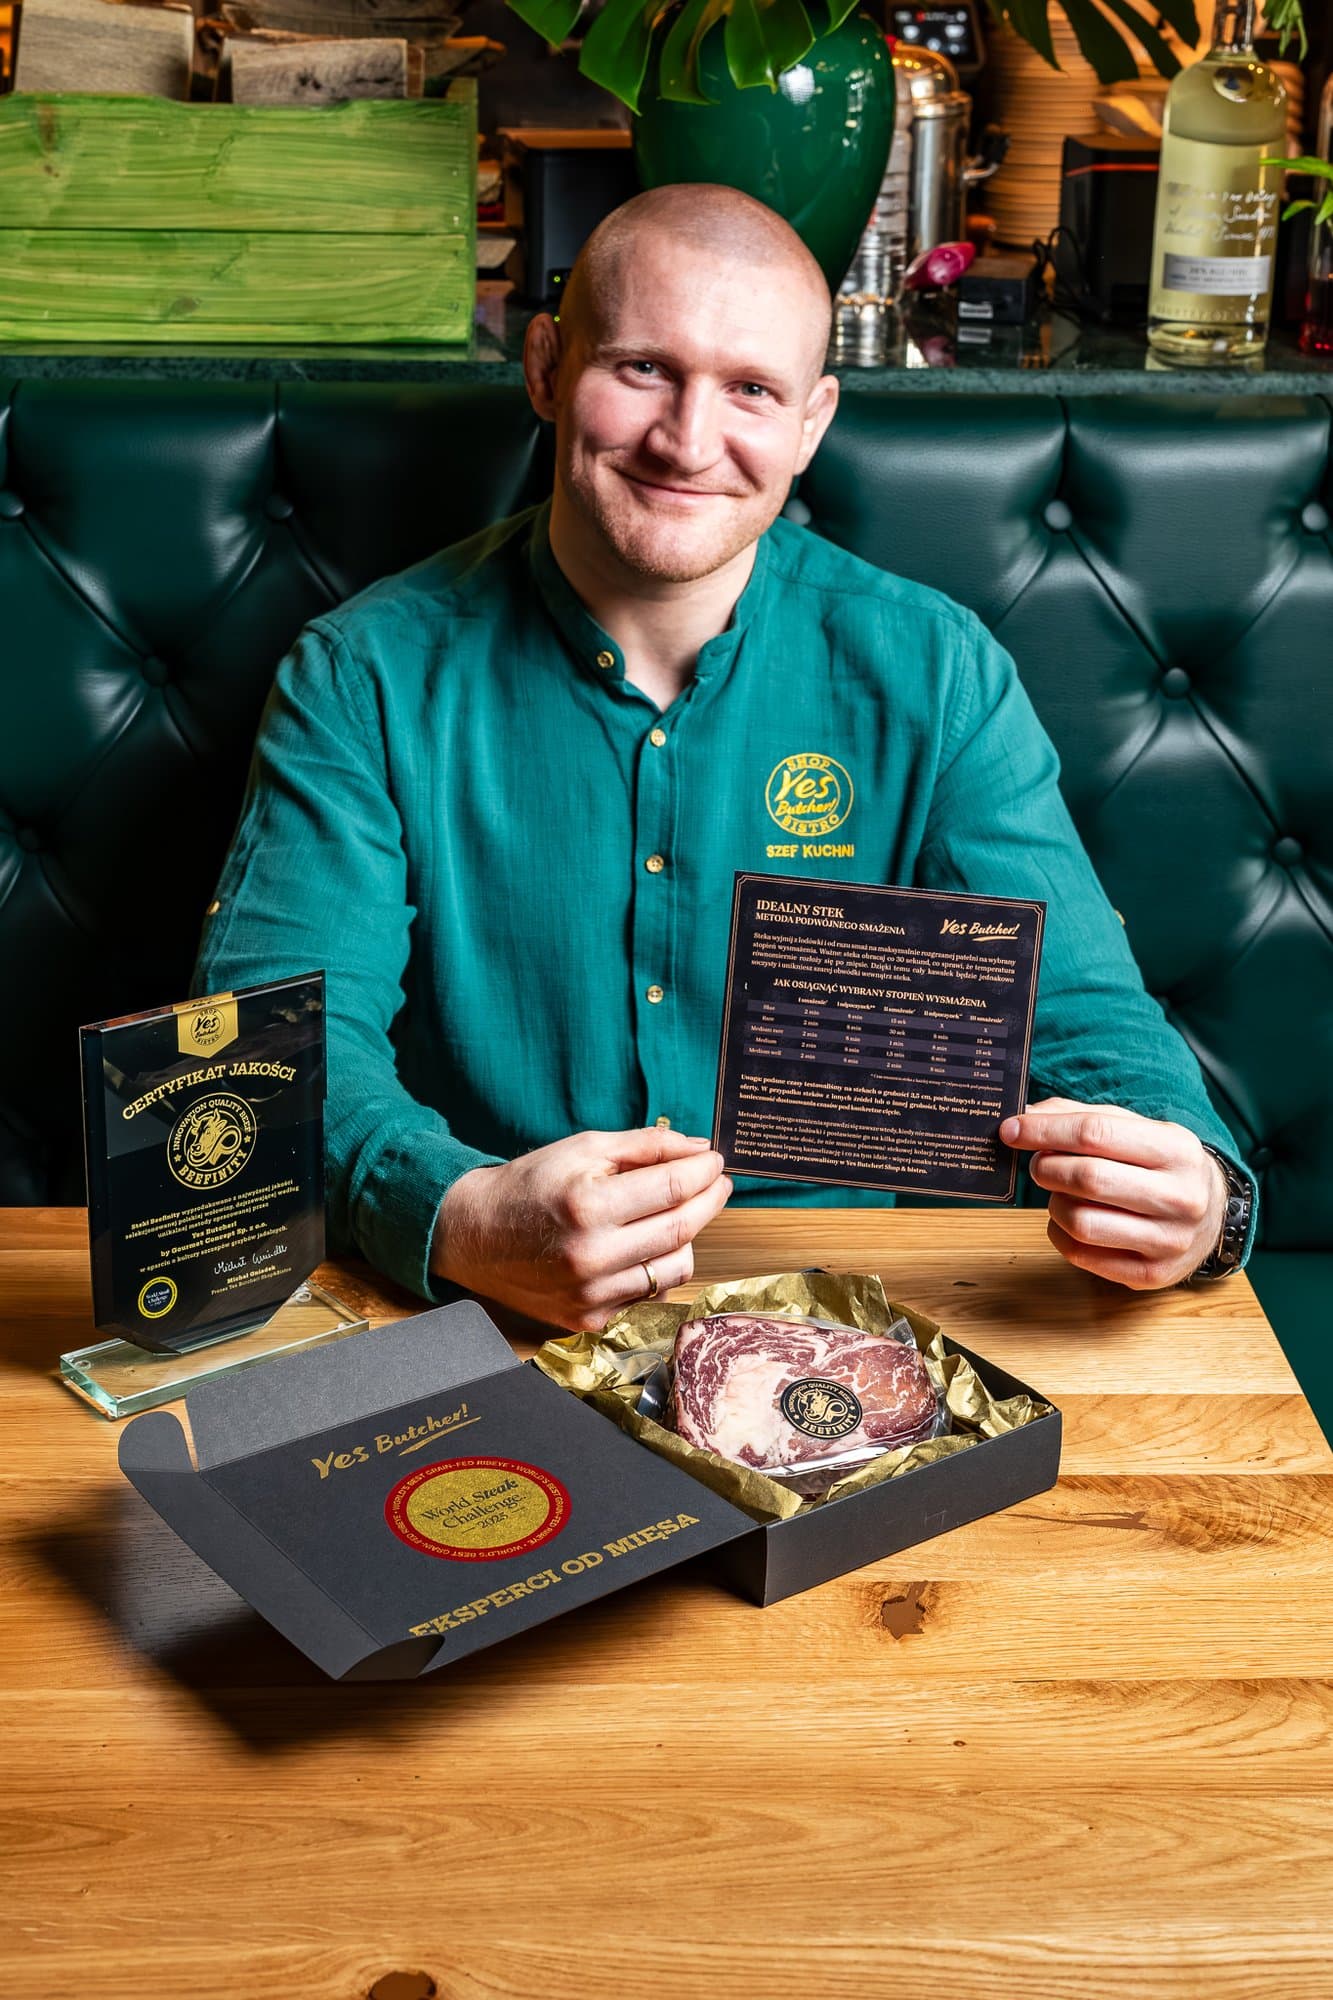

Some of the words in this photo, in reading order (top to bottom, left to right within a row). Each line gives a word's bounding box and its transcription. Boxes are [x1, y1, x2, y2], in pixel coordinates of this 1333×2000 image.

[786, 756, 831, 772] SHOP
[774, 770, 834, 802] Yes
[775, 798, 838, 816] Butcher!
[782, 814, 840, 832] BISTRO
[766, 844, 798, 858] SZEF
[802, 844, 854, 858] KUCHNI
[757, 899, 810, 914] IDEALNY
[812, 905, 843, 918] STEK
[755, 912, 793, 923] METODA
[795, 916, 857, 929] PODWÓJNEGO
[858, 923, 904, 934] SMAŻENIA
[940, 919, 967, 934] Yes
[968, 922, 1020, 936] Butcher!
[753, 932, 771, 940] Steka
[771, 935, 793, 944] wyjmij
[798, 936, 823, 945] lodówki
[988, 957, 1016, 966] wybrany
[974, 964, 1015, 974] temperatura
[773, 978, 790, 987] JAK
[791, 980, 838, 993] OSIĄGNĄĆ
[839, 985, 884, 996] WYBRANY
[885, 990, 924, 1000] STOPIEŃ
[925, 994, 986, 1007] WYSMAŻENIA
[194, 1016, 218, 1032] Yes
[122, 1064, 226, 1120] CERTYFIKAT
[229, 1061, 296, 1082] JAKOŚCI
[173, 1102, 207, 1151] INNOVATION
[208, 1098, 241, 1113] QUALITY
[240, 1108, 252, 1133] BEEF
[178, 1150, 248, 1184] BEEFINITY
[808, 1383, 839, 1392] QUALITY
[801, 1414, 857, 1434] BEEFINITY
[312, 1446, 370, 1480] Yes
[374, 1403, 469, 1454] Butcher!
[408, 1472, 426, 1490] BEST
[426, 1460, 474, 1475] GRAIN-FED
[476, 1460, 509, 1468] RIBEYE
[420, 1497, 472, 1521] World
[472, 1479, 518, 1503] Steak
[442, 1494, 526, 1528] Challenge.
[477, 1512, 508, 1529] 2025
[408, 1569, 562, 1637] EKSPERCI
[561, 1552, 604, 1576] OD
[602, 1512, 700, 1559] MIĘSA
